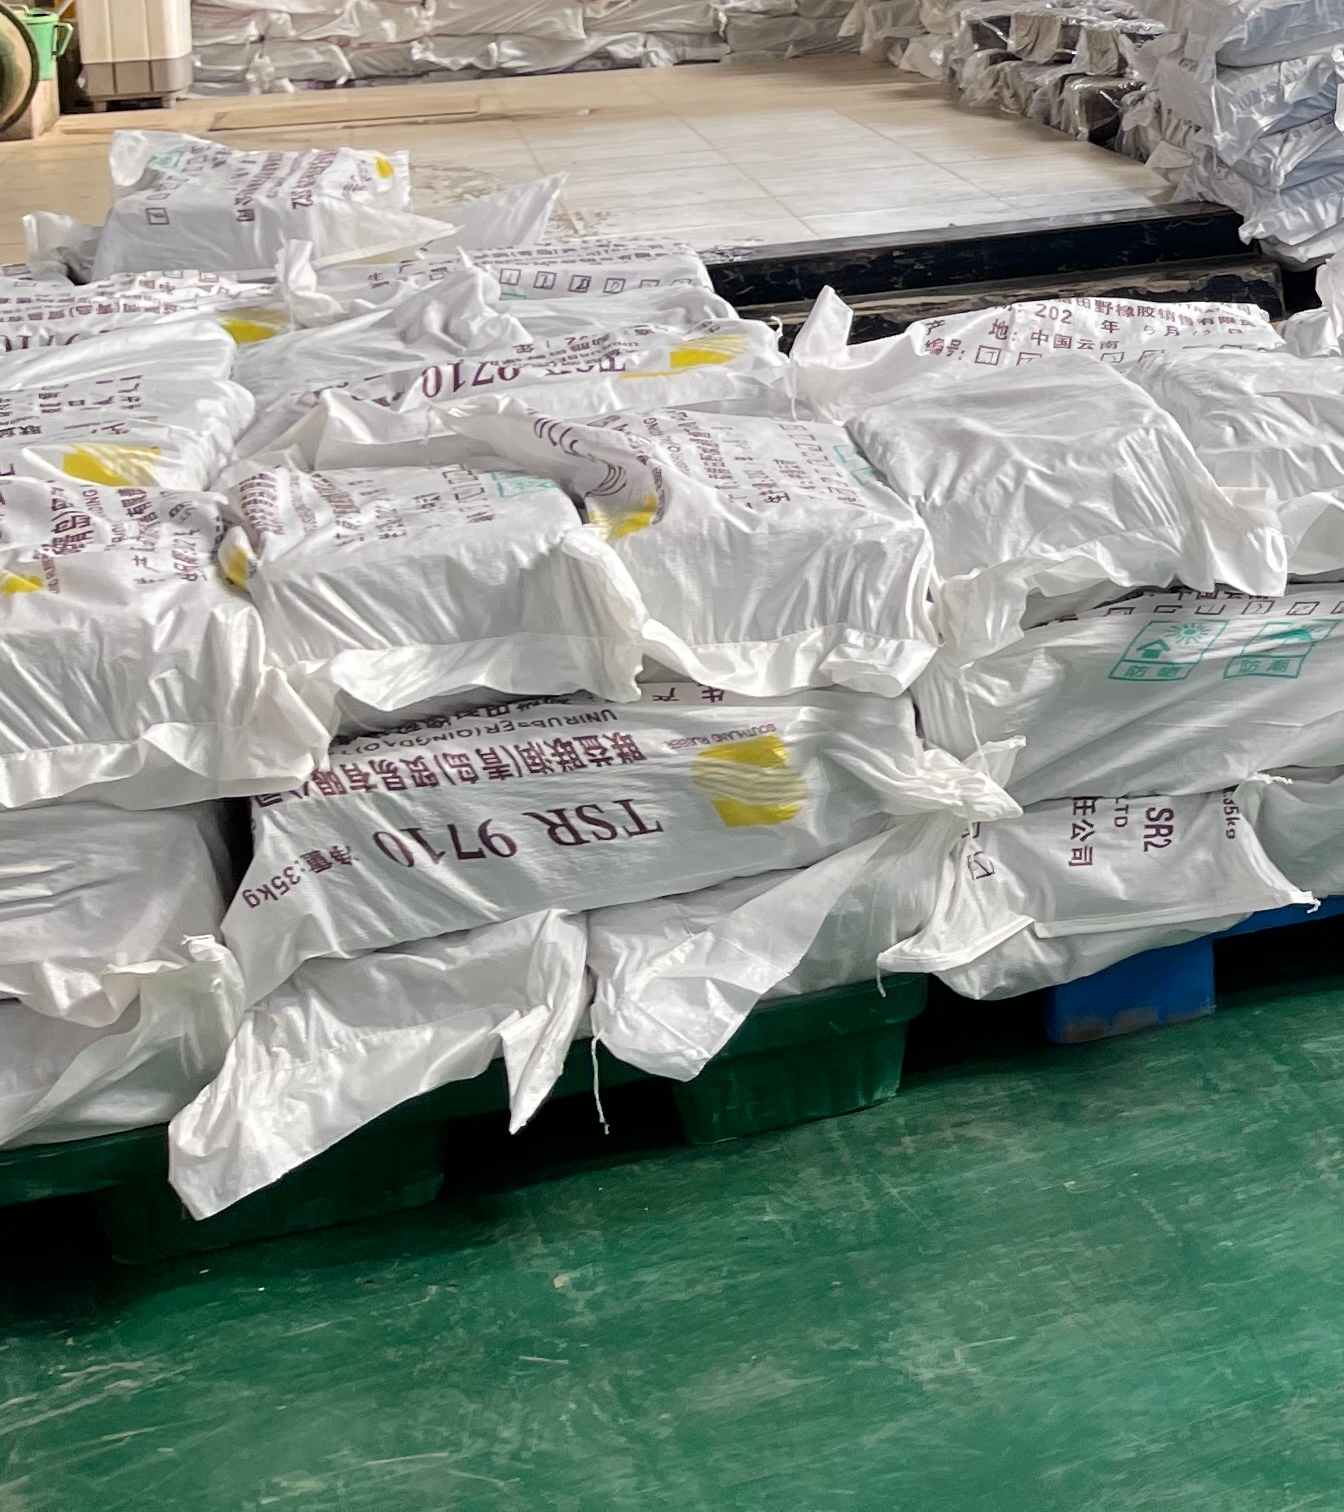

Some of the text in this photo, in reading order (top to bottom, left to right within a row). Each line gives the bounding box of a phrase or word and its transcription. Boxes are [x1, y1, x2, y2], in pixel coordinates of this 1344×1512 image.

[371, 797, 665, 869] TSR 9710
[1142, 807, 1175, 852] SR2
